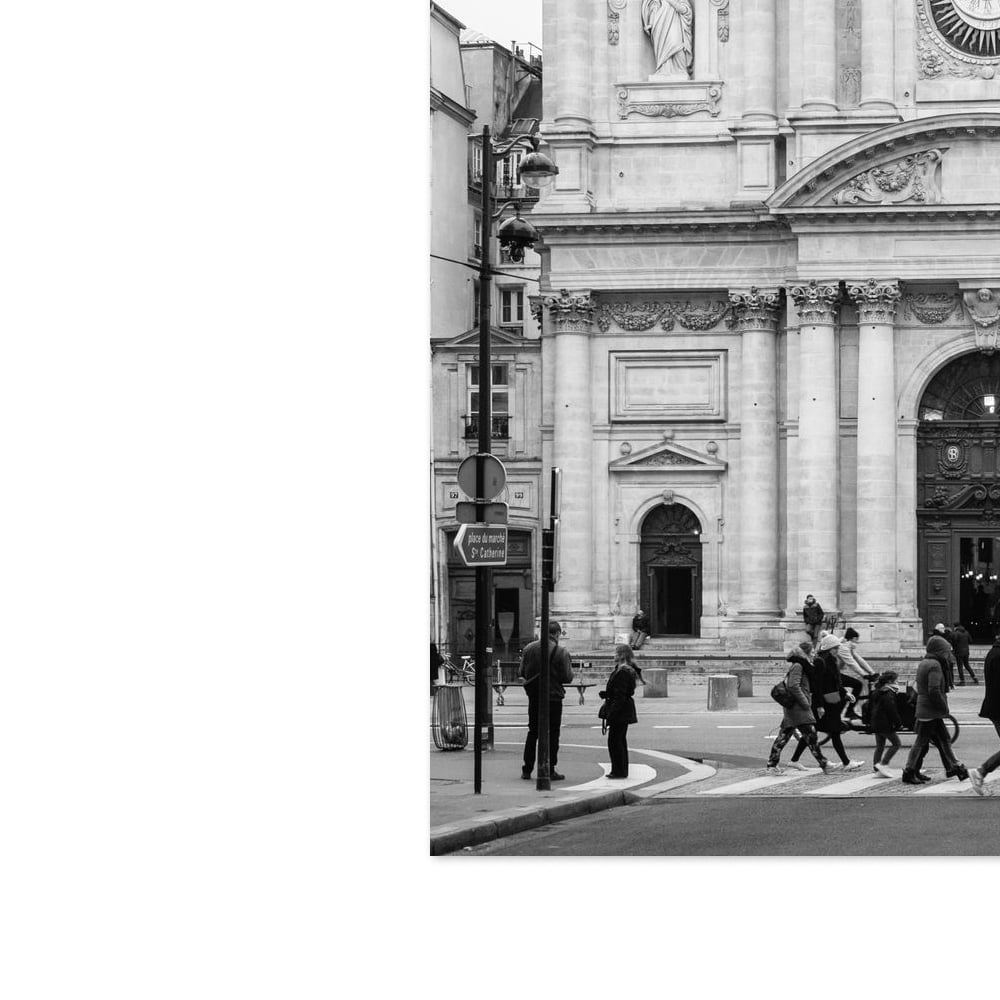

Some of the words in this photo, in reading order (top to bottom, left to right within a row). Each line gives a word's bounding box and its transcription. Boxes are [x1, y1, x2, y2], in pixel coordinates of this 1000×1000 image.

[468, 532, 481, 547] place
[482, 532, 488, 544] du
[488, 531, 505, 544] marché
[480, 546, 505, 559] Catherine
